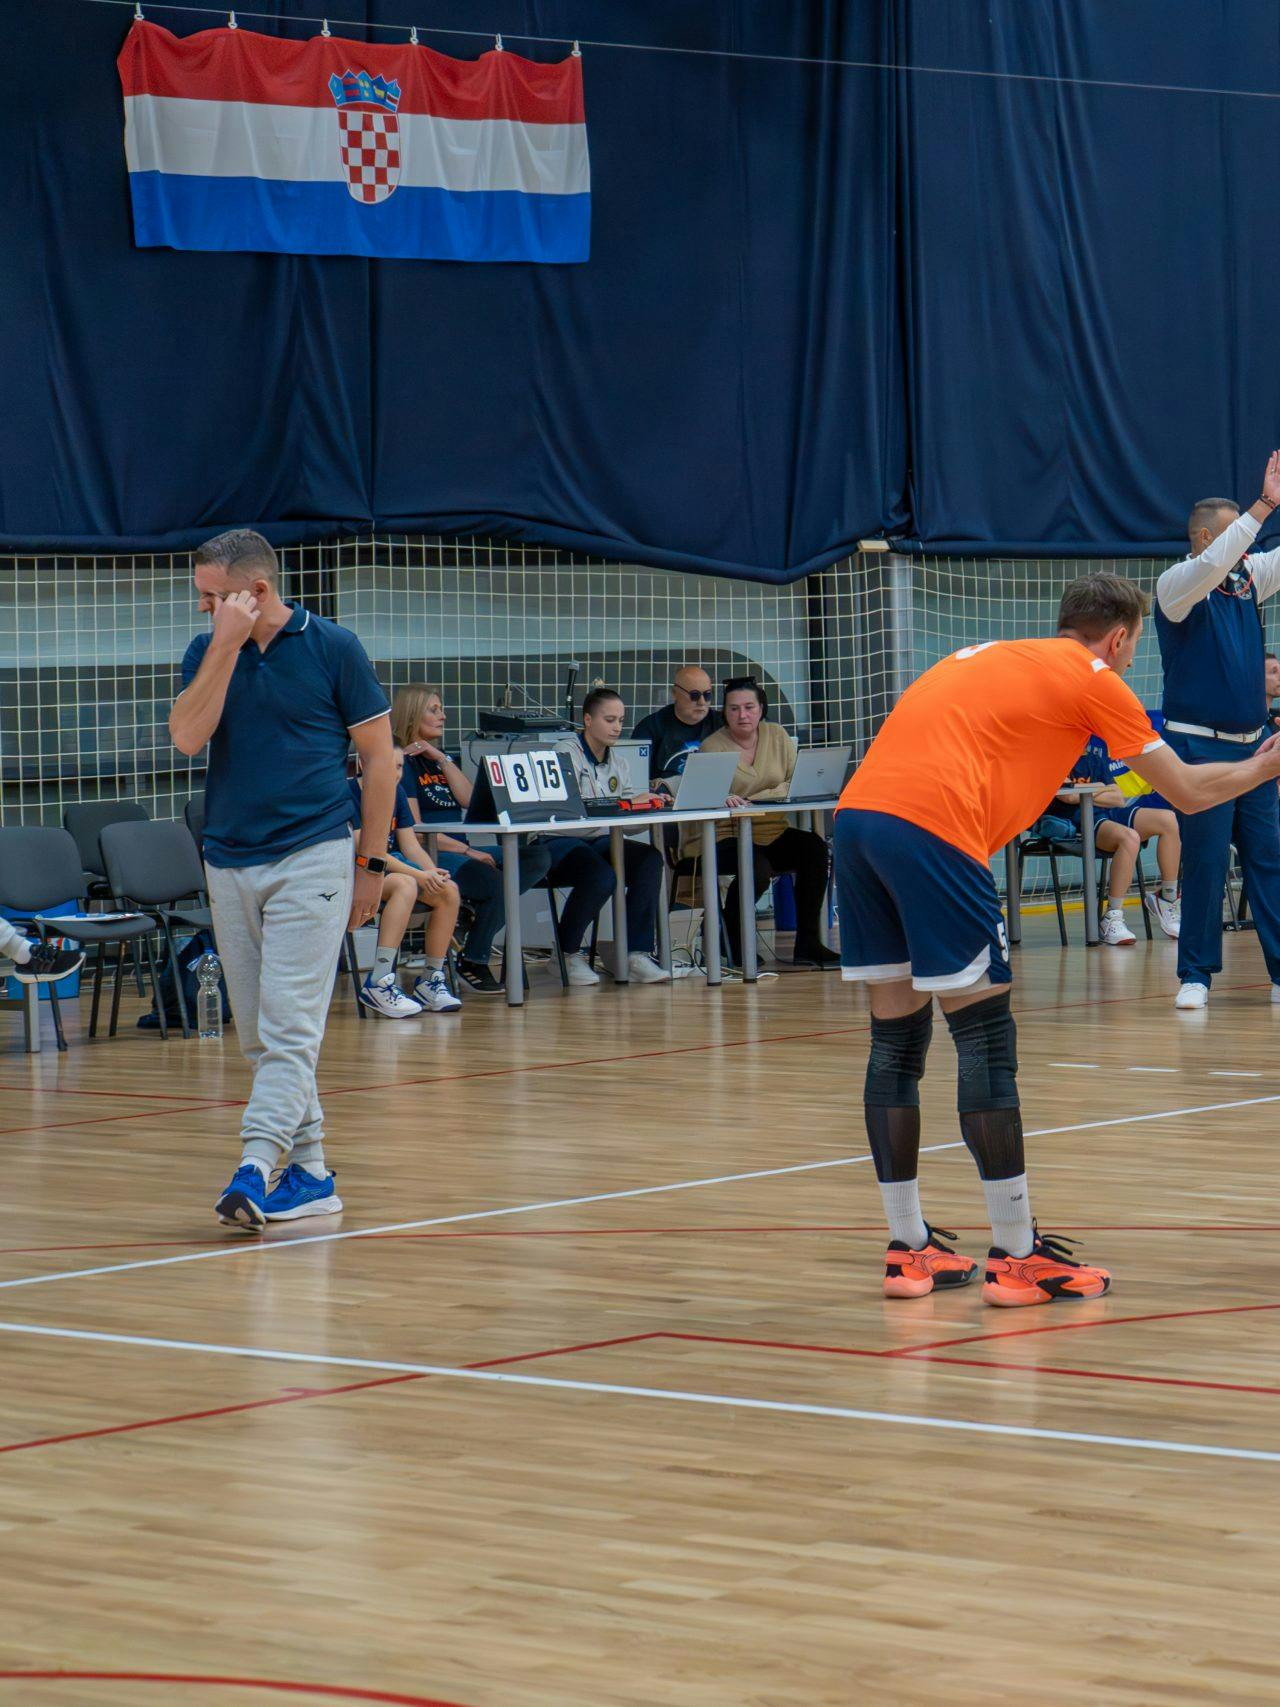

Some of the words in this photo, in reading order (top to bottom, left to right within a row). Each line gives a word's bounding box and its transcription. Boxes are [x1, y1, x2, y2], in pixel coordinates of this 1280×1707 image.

[490, 761, 503, 785] 0
[513, 763, 530, 793] 8
[536, 759, 561, 789] 15
